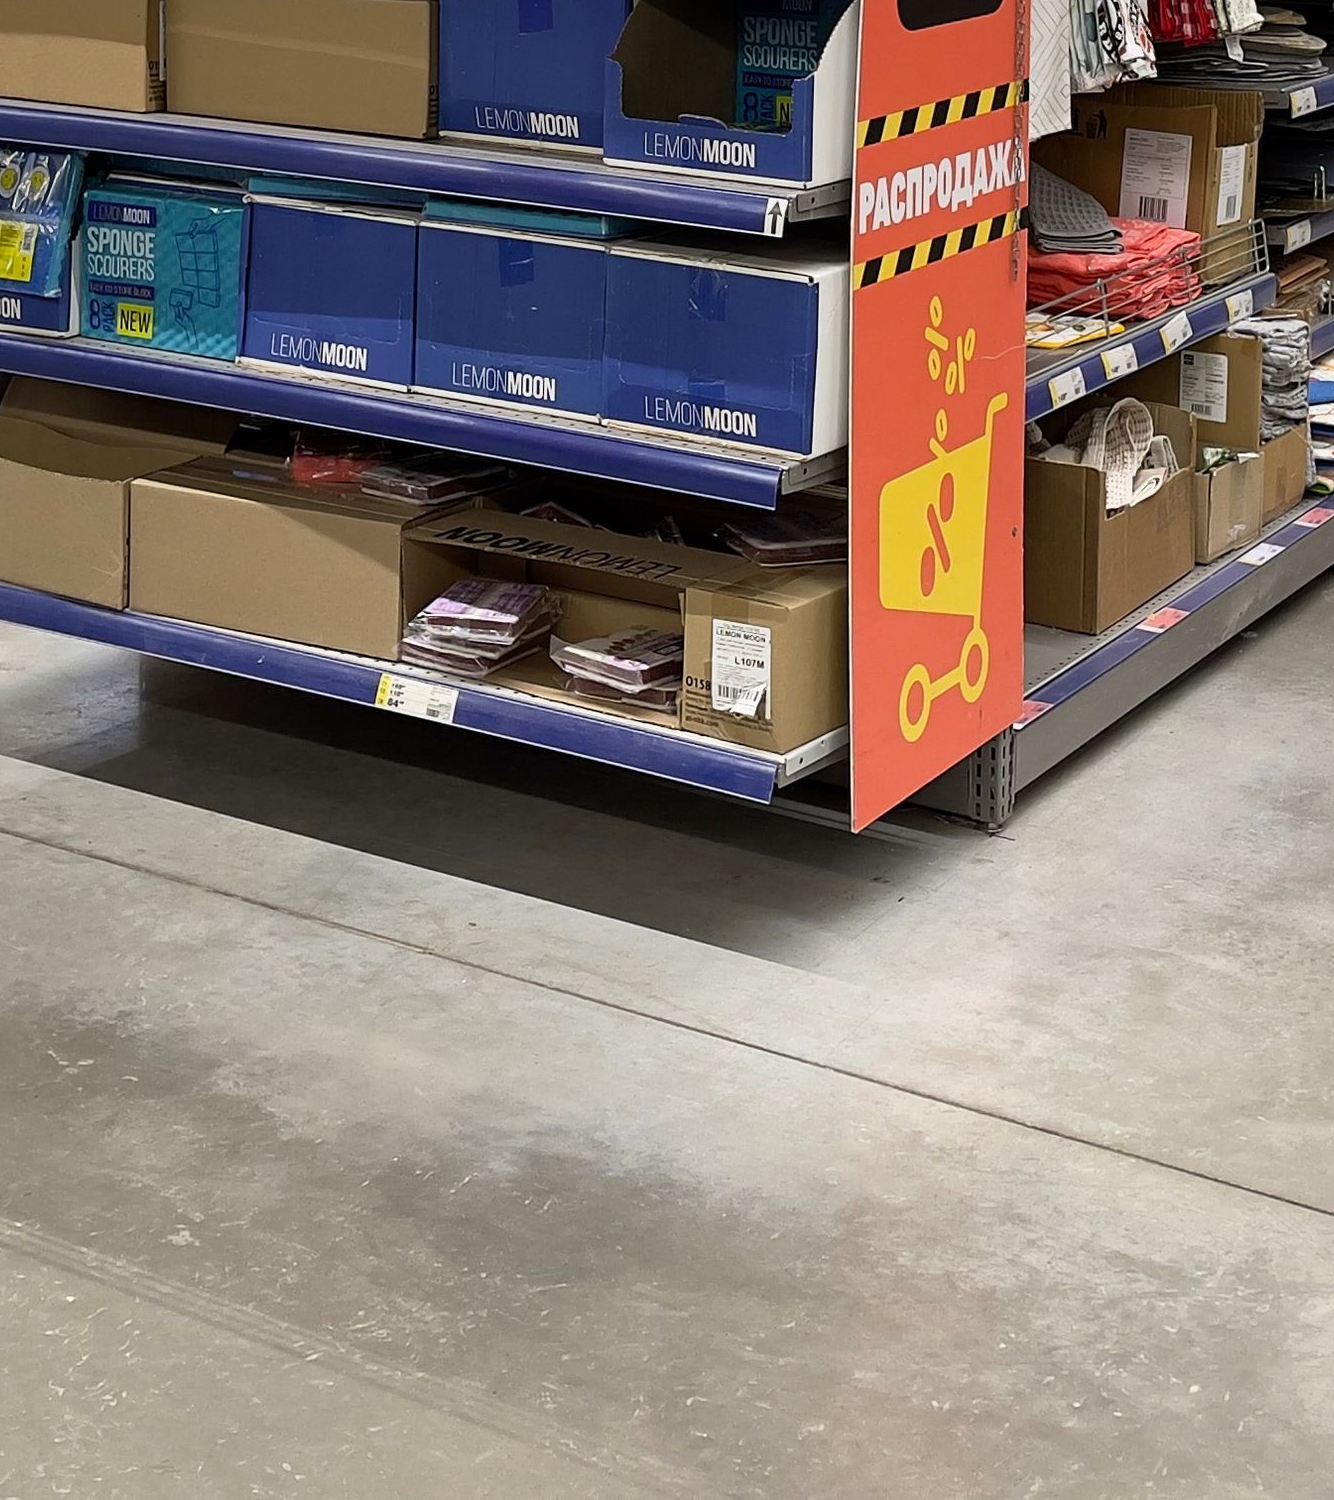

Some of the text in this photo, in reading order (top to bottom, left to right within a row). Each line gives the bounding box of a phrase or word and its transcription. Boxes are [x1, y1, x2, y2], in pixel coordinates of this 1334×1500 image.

[743, 16, 817, 47] SPONGE
[743, 44, 818, 71] SCOURERS
[475, 105, 579, 139] LEMONMOON
[760, 94, 775, 122] ACK
[644, 131, 756, 169] LEMONMOON
[859, 137, 1026, 235] РАСПРОДАЖА
[92, 204, 150, 224] LEMONMOON
[87, 226, 156, 258] SPONGE
[87, 253, 155, 281] SCOURERS
[89, 298, 101, 330] 8
[102, 301, 115, 333] PACK
[120, 309, 151, 333] NEW
[270, 332, 367, 372] LEMONMOON
[451, 361, 556, 402] LEMONMOON
[644, 396, 757, 438] LEMONMOON
[434, 525, 682, 581] LEMONMOON
[715, 626, 766, 643] LEMON MOON
[734, 656, 765, 670] L107M
[685, 675, 711, 691] 0158
